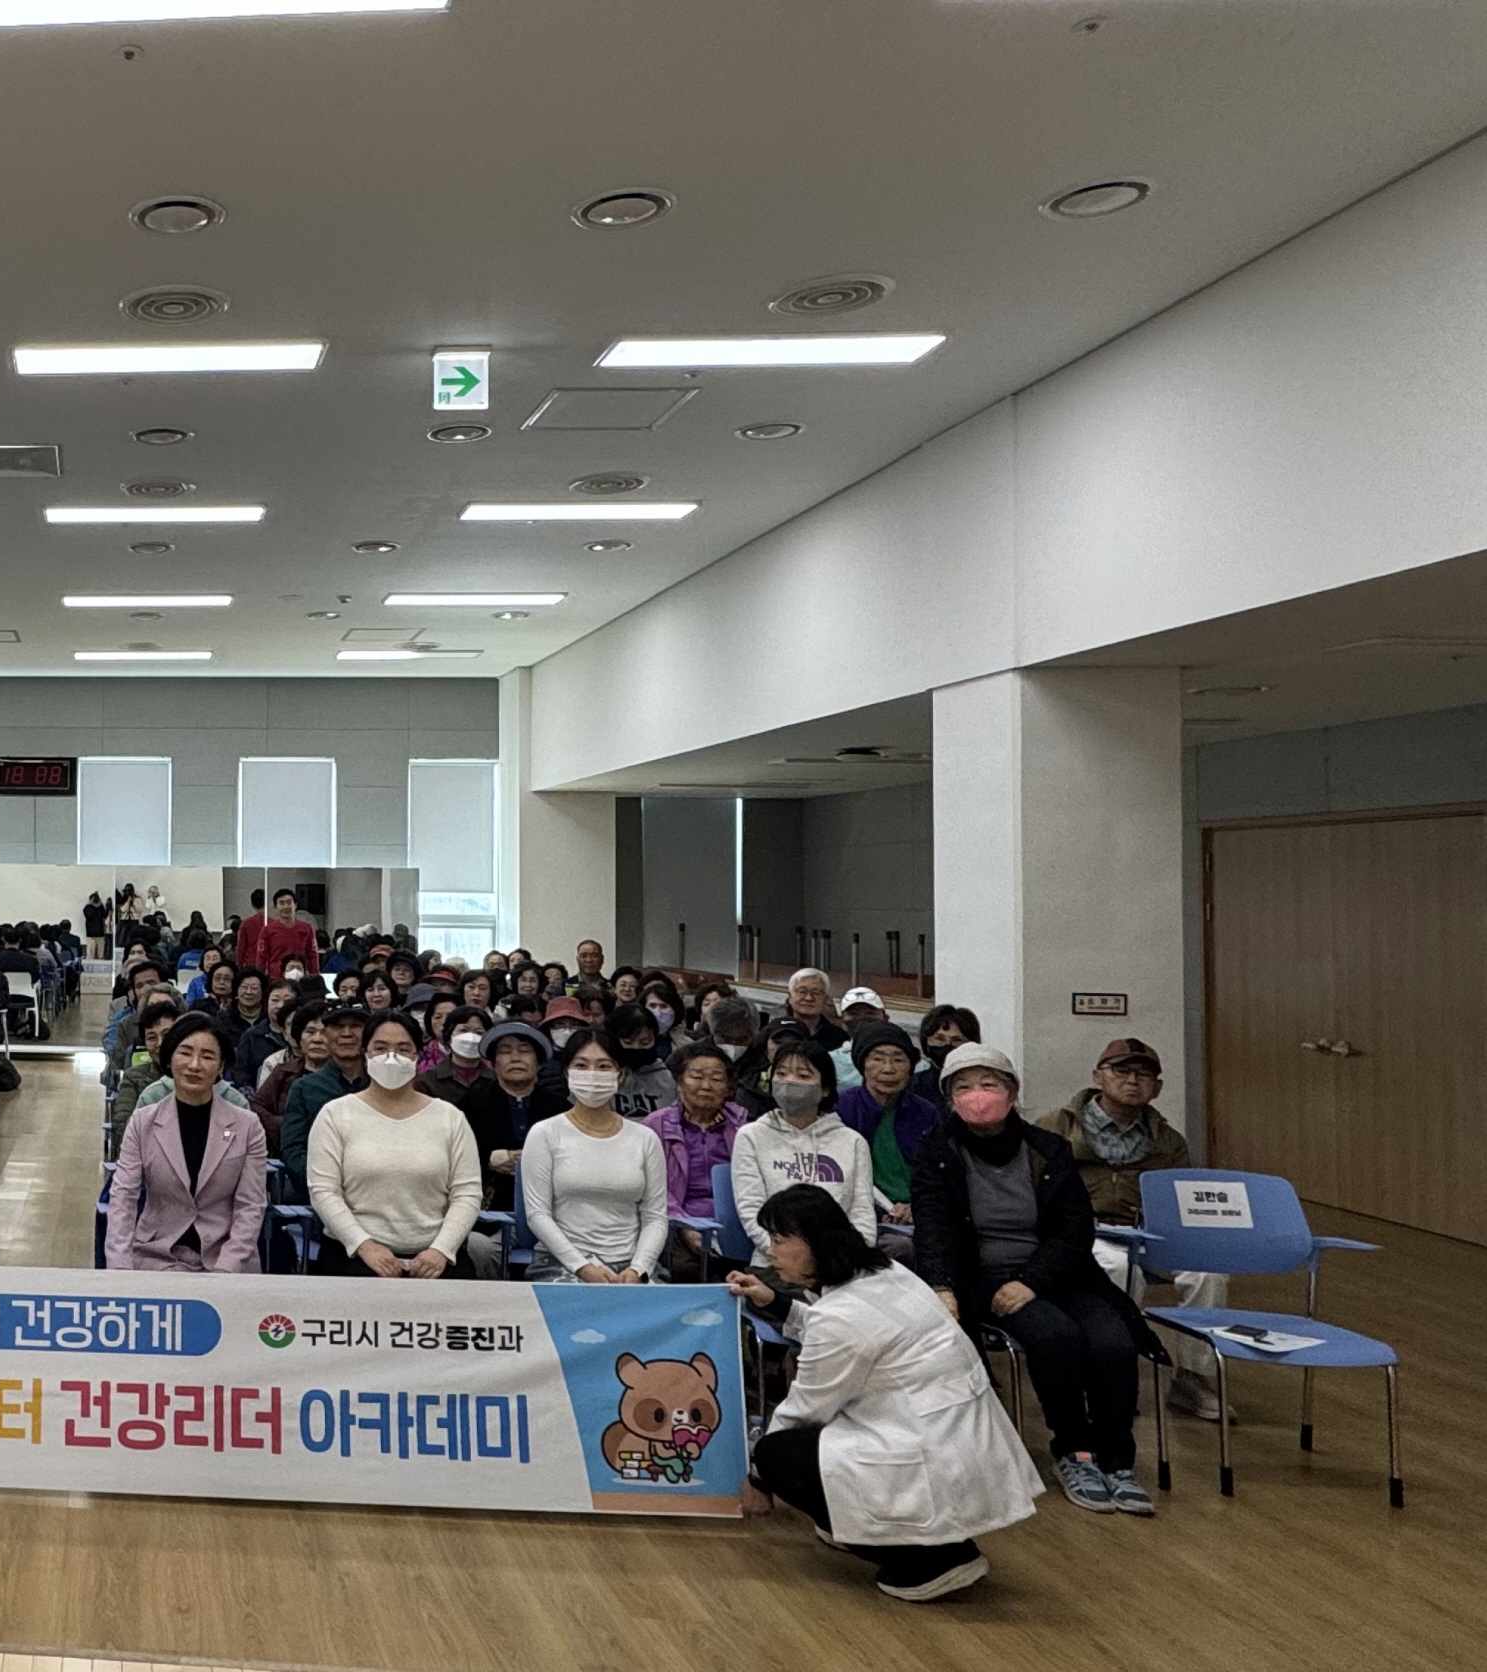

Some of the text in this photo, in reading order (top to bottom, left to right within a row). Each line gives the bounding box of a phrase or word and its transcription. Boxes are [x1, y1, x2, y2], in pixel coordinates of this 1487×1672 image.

[614, 1093, 659, 1117] CAT
[12, 1300, 183, 1352] 건강하게
[301, 1319, 524, 1353] 구리시 건강증진과
[60, 1380, 282, 1454] 건강리더
[299, 1389, 531, 1464] 아카데미
